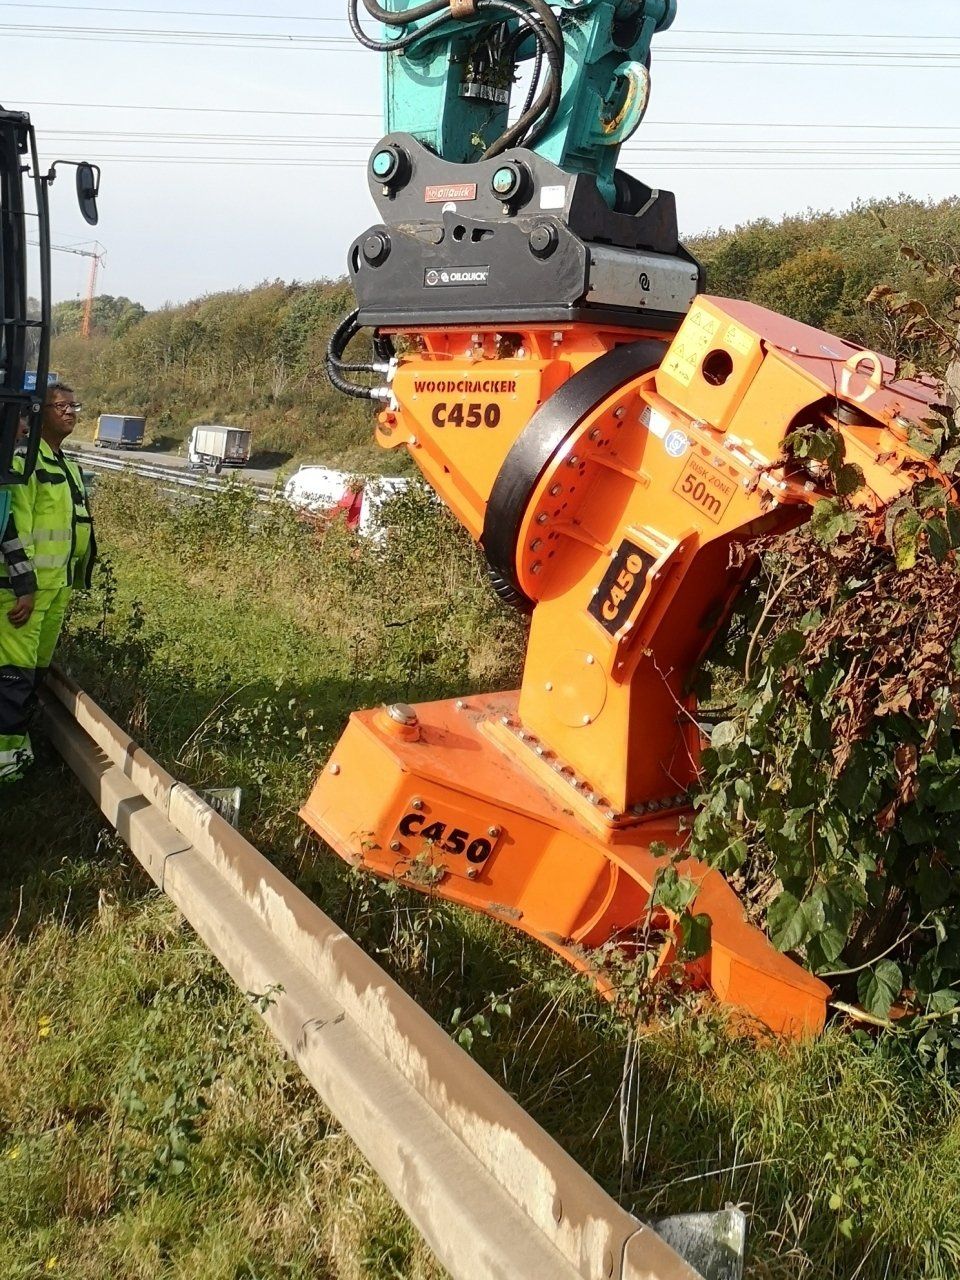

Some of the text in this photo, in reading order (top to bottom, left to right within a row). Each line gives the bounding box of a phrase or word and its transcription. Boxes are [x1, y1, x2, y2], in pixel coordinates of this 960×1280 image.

[414, 380, 517, 393] WOODCRACKER
[431, 402, 501, 428] C450
[682, 473, 721, 515] 50m
[689, 460, 731, 496] RISK ZONE
[602, 554, 643, 620] C450
[399, 813, 491, 863] C450
